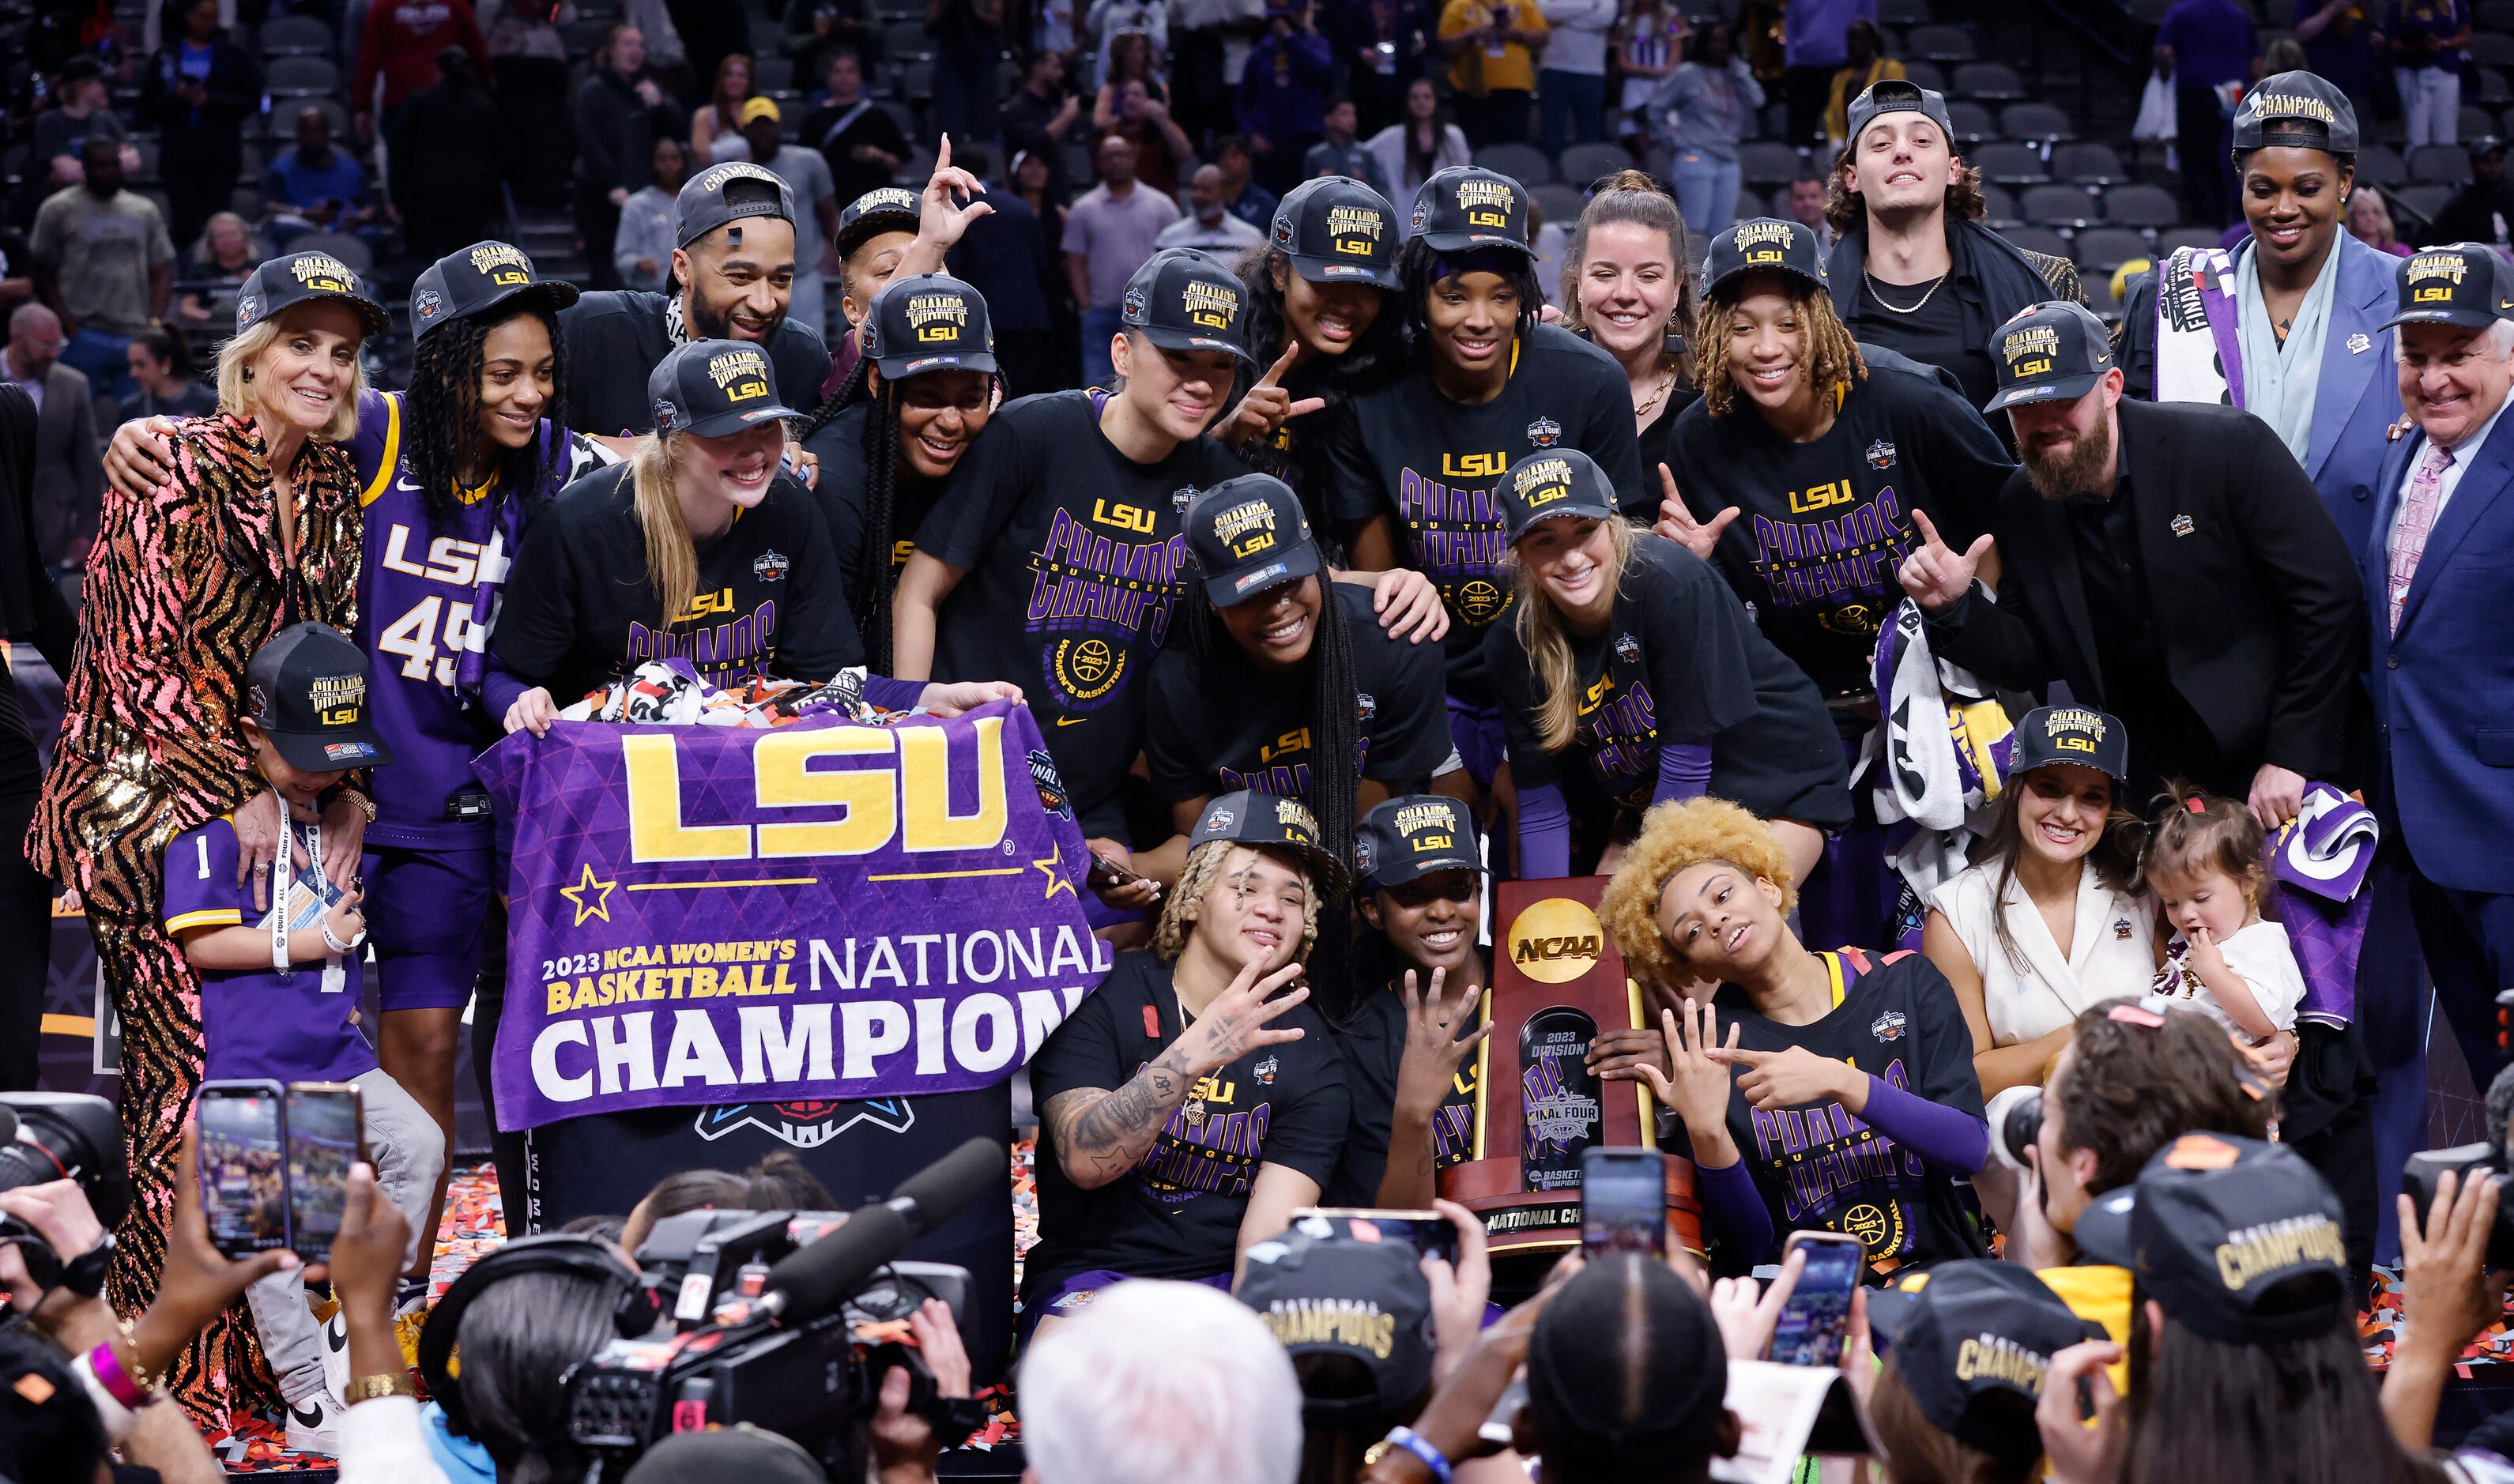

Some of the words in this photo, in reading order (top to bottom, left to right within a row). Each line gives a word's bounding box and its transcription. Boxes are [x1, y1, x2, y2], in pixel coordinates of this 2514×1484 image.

[2256, 99, 2335, 123] CHAMPIONS
[2267, 94, 2324, 105] NATIONAL
[1461, 183, 1511, 214] CHAMPS
[1330, 209, 1380, 242] CHAMPS
[1469, 211, 1505, 228] LSU
[1336, 239, 1372, 255] LSU
[1736, 224, 1791, 253] CHAMPS
[471, 246, 529, 274] CHAMPS
[1746, 250, 1783, 263] LSU
[493, 272, 530, 286] LSU
[2407, 256, 2464, 286] CHAMPS
[307, 279, 346, 292] LSU
[1183, 293, 1211, 302] NATIONAL
[2414, 288, 2452, 302] LSU
[909, 297, 966, 330] CHAMPS
[1185, 284, 1236, 323] CHAMPS
[1193, 312, 1227, 330] LSU
[918, 326, 958, 342] LSU
[2003, 343, 2025, 352] NATIONAL
[2005, 329, 2057, 366] CHAMPS
[710, 352, 767, 390] CHAMPS
[2014, 358, 2051, 378] LSU
[726, 381, 768, 402] LSU
[1442, 451, 1506, 477] LSU
[1868, 451, 1881, 460] FINAL
[1515, 461, 1571, 500] CHAMPS
[1528, 485, 1567, 508] LSU
[1788, 479, 1853, 514] LSU
[1092, 498, 1156, 533] LSU
[1214, 502, 1276, 548] CHAMPS
[1215, 520, 1240, 536] NATIONAL
[1242, 511, 1274, 523] CHAMPIONS
[382, 524, 481, 586] LS
[1233, 532, 1275, 559] LSU
[1755, 561, 1797, 572] LSU
[1820, 529, 1912, 563] TIGERS
[756, 562, 771, 571] FINAL
[1027, 507, 1188, 648] CHAMPS
[1034, 558, 1079, 576] LSU
[1099, 574, 1183, 595] TIGERS
[670, 587, 734, 623] LSU
[378, 595, 472, 686] 45
[704, 651, 775, 672] IGERS
[1055, 638, 1076, 695] WOMEN'S
[1076, 649, 1126, 699] BASKETBALL
[1081, 655, 1102, 666] 2023
[309, 690, 339, 699] NATIONAL
[312, 675, 364, 714] CHAMPS
[827, 689, 855, 702] DALLAS
[322, 707, 358, 725] LSU
[2048, 711, 2103, 743] CHAMPS
[2056, 737, 2094, 753] LSU
[622, 716, 1008, 864] LSU
[1395, 815, 1423, 825] NATIONAL
[1397, 805, 1456, 838] CHAMPS
[1412, 835, 1452, 852] LSU
[196, 835, 210, 879] 1
[324, 930, 333, 944] ALL
[542, 958, 601, 981] 2023
[603, 947, 666, 971] NCAA
[671, 939, 797, 965] WOMEN'S
[809, 924, 1112, 992] NATIONAL
[1513, 935, 1600, 965] NCAA
[545, 966, 797, 1016] BASKETBALL
[1547, 1031, 1576, 1043] 2023
[1874, 1023, 1890, 1034] FINAL
[1890, 1019, 1905, 1027] FOUR
[1532, 1044, 1585, 1058] DIVISION
[1529, 1108, 1561, 1122] FINAL
[1566, 1107, 1596, 1119] FOUR
[1488, 1209, 1556, 1230] NATIONAL
[1853, 1220, 1877, 1231] 2023
[1868, 1199, 1904, 1262] BASKETBALL
